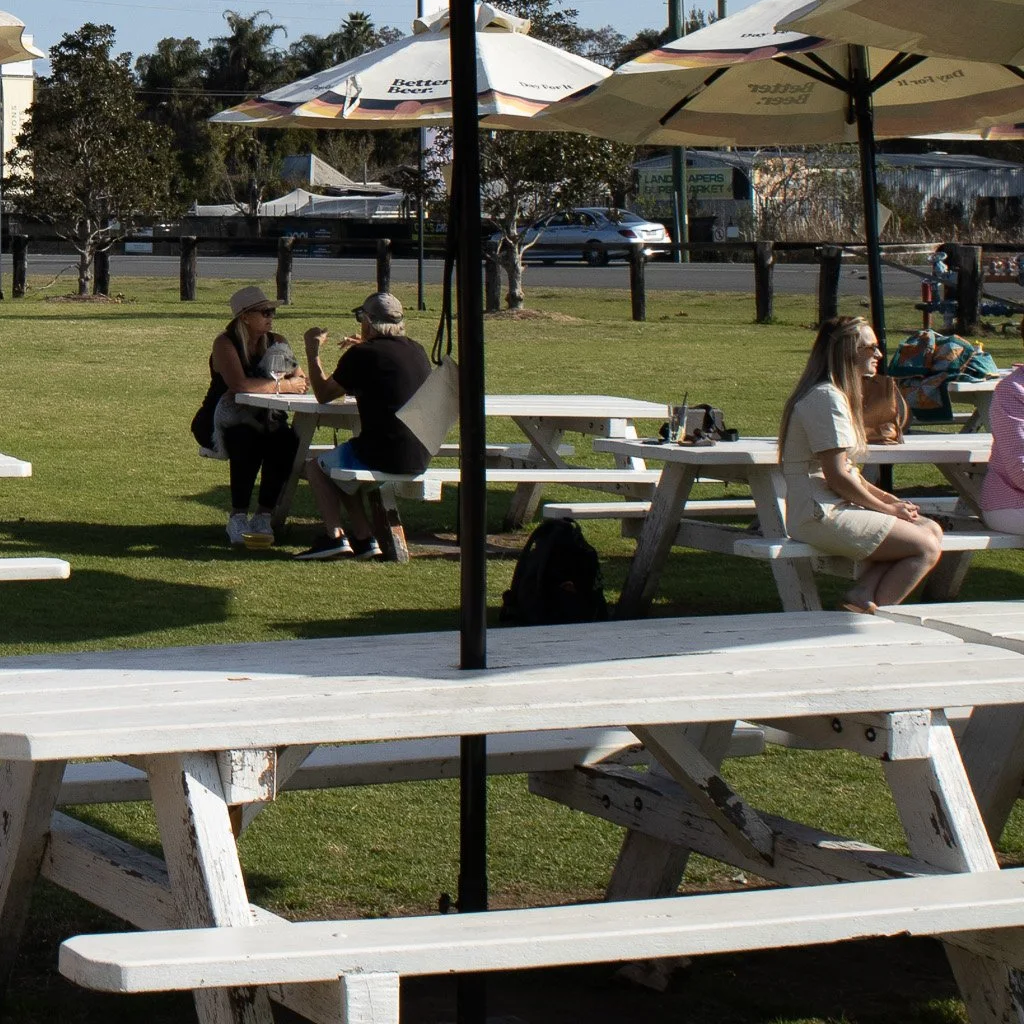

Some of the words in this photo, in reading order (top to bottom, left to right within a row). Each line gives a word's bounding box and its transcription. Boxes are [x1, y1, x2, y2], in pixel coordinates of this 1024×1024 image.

[391, 78, 452, 88] Better
[387, 86, 434, 95] Beer.
[644, 173, 725, 184] LANDAPERS
